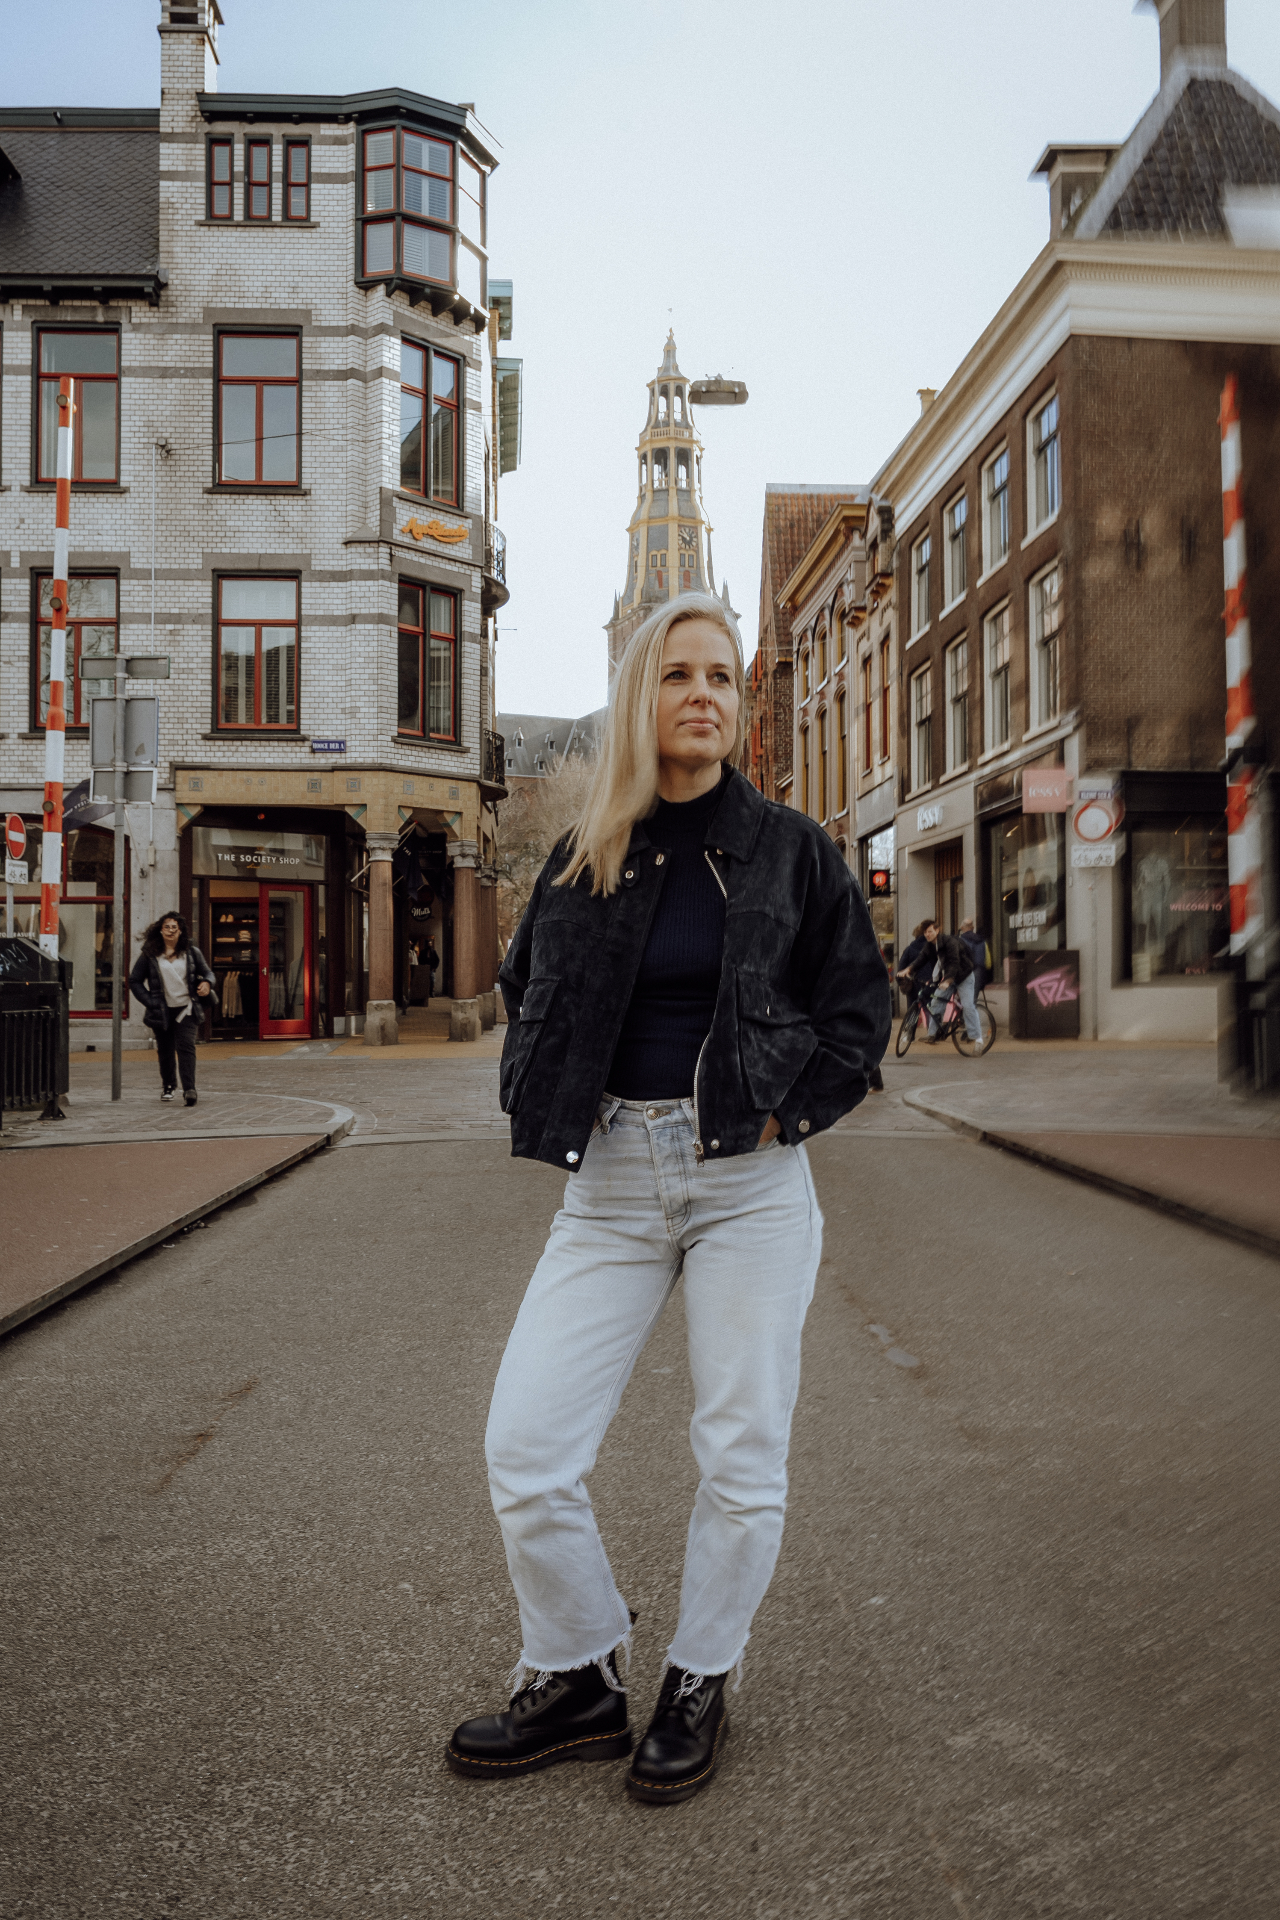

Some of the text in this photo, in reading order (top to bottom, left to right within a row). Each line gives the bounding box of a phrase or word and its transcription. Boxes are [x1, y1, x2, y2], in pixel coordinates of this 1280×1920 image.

[217, 853, 300, 865] THE SOCIETY SHOP
[1169, 903, 1222, 911] WELCOME TO
